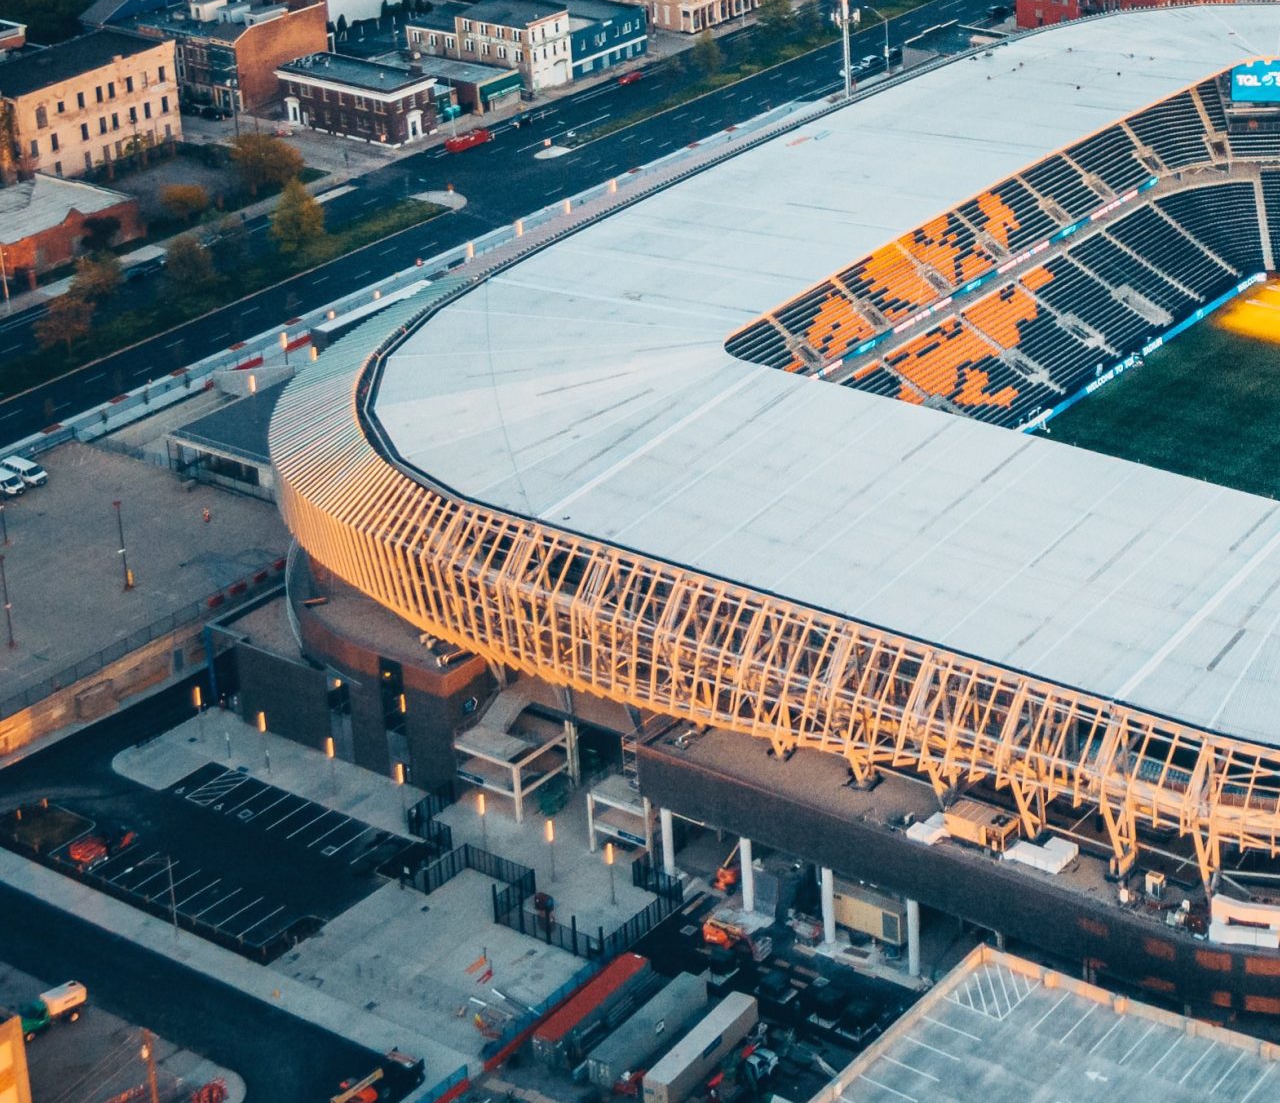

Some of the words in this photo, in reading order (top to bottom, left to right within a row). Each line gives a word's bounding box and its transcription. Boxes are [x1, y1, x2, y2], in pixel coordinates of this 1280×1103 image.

[1236, 74, 1262, 87] TQL
[1085, 369, 1115, 394] WELCOME
[1114, 363, 1124, 376] TO
